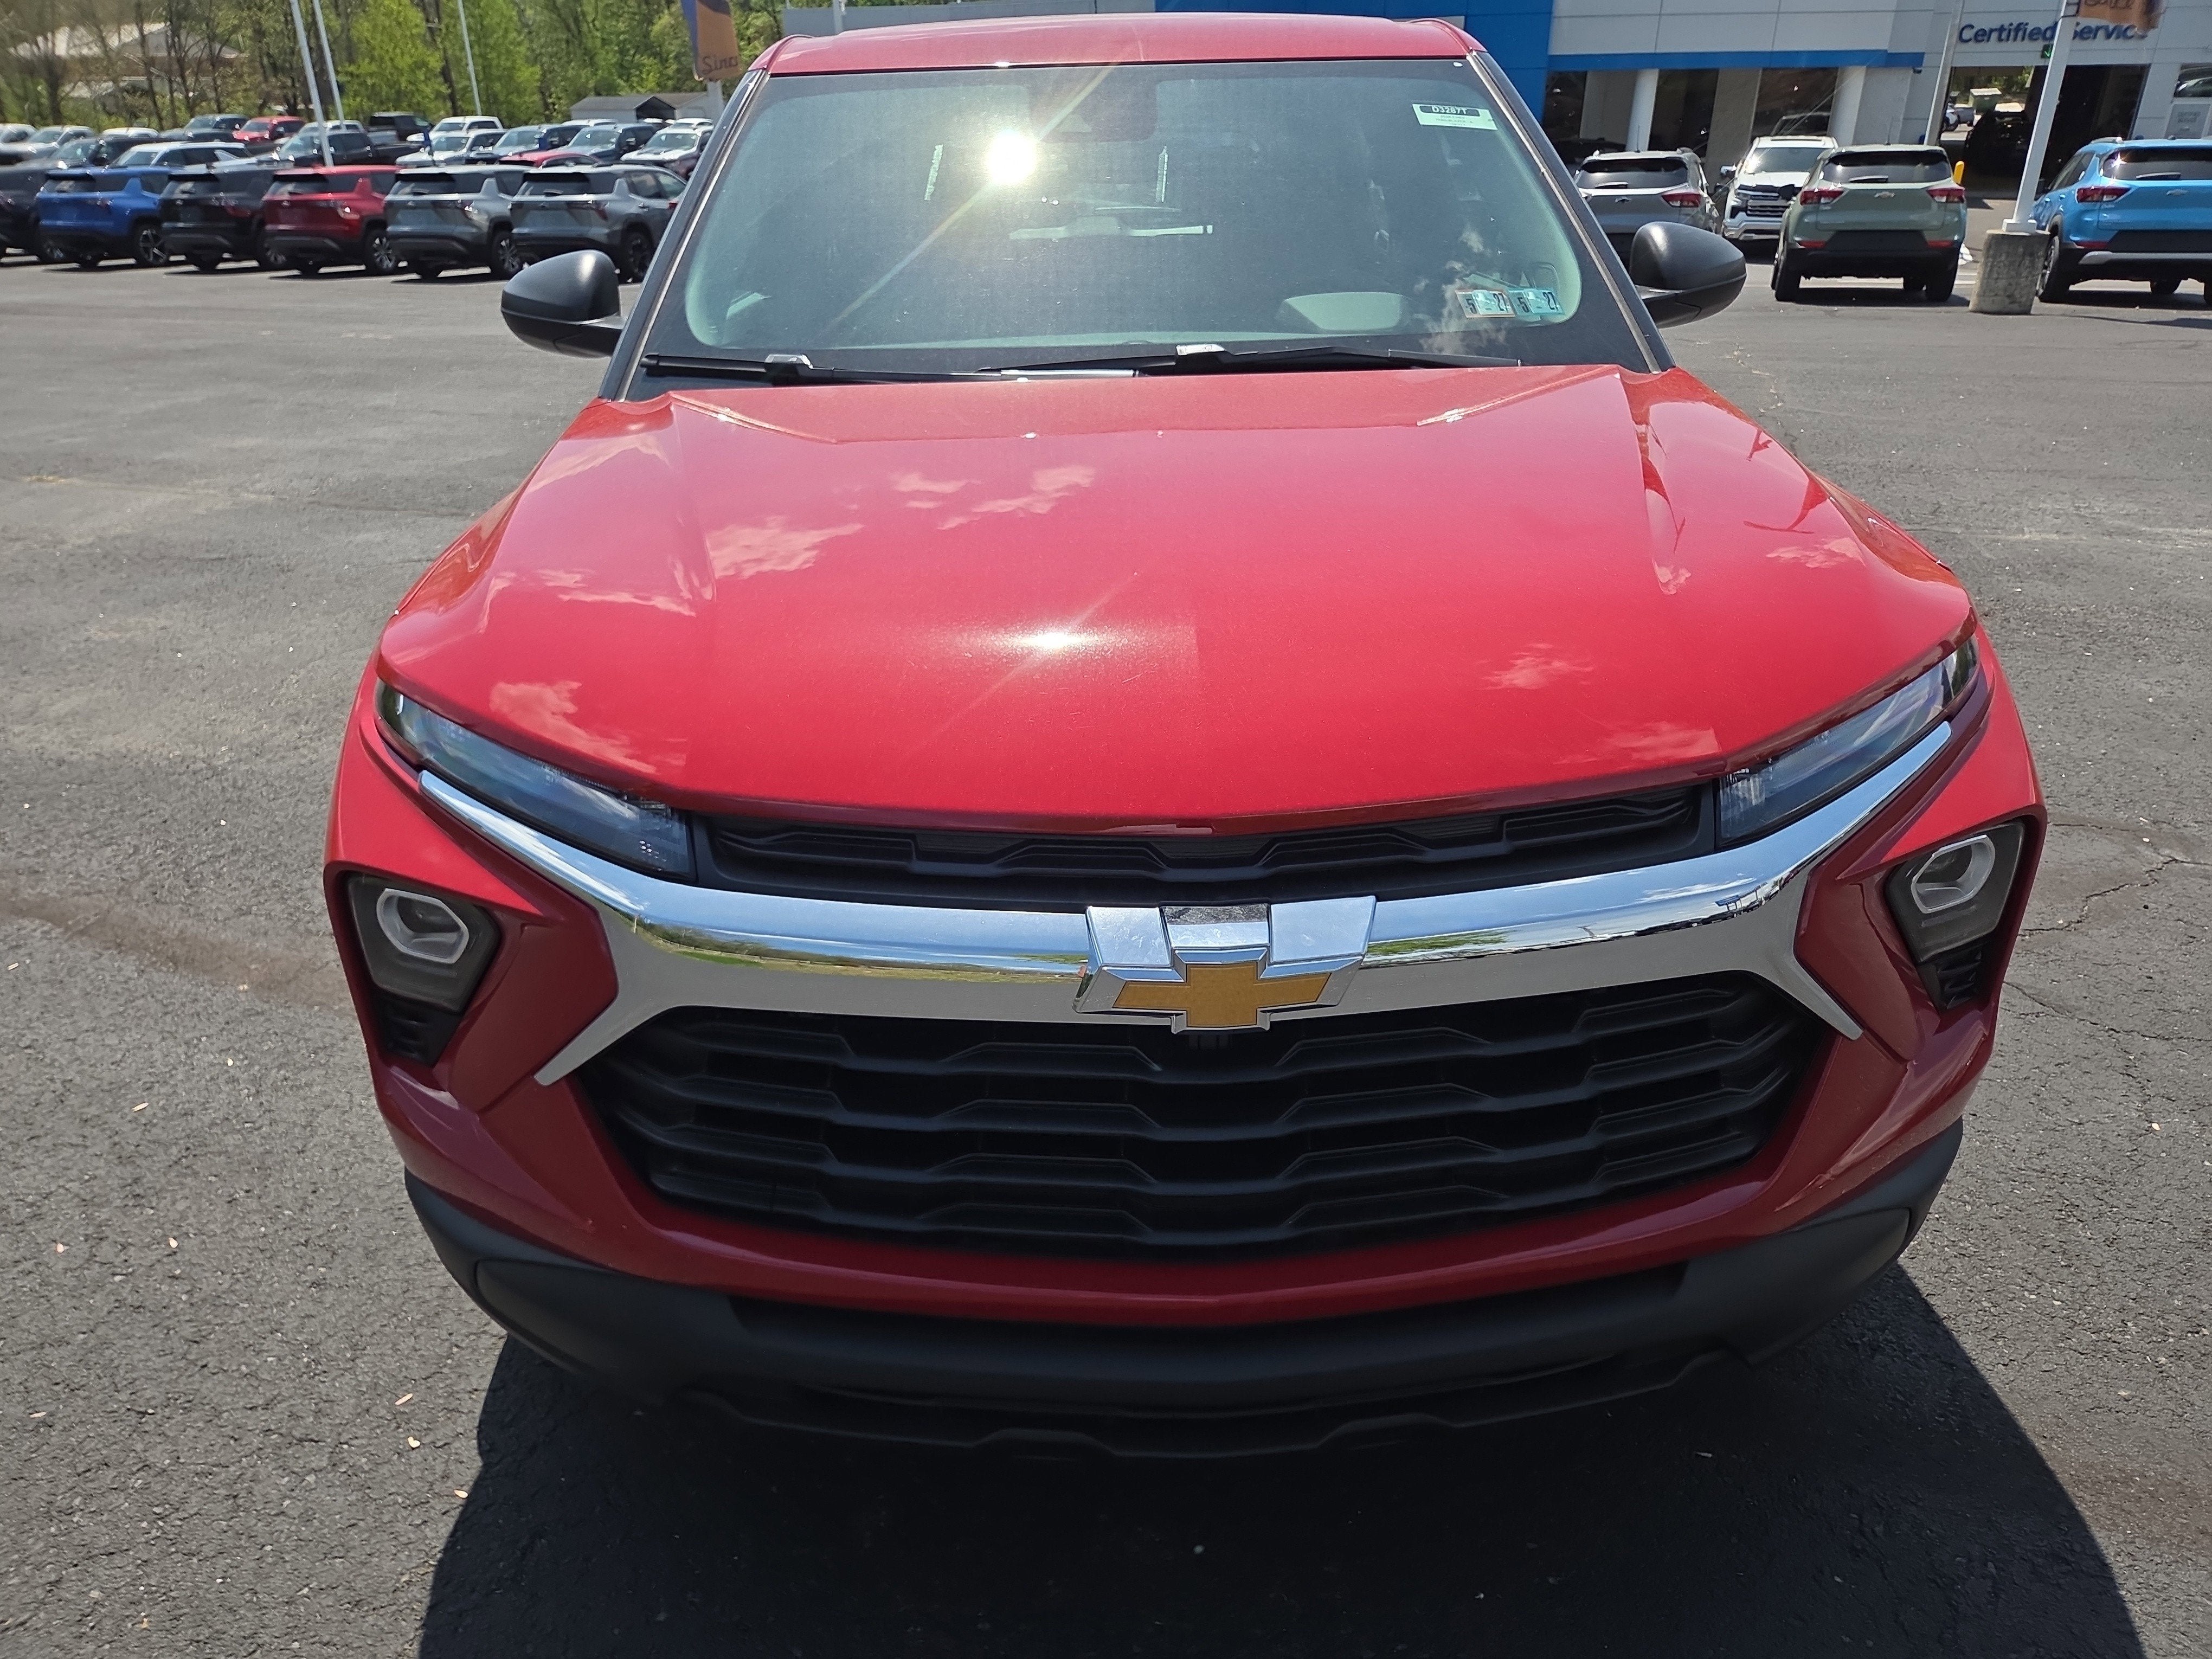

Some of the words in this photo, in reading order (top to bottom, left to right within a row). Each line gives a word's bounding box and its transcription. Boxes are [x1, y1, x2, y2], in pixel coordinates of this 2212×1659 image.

[1958, 21, 2059, 43] Certified
[1432, 105, 1468, 115] D3287T
[1465, 299, 1477, 314] 5
[1493, 293, 1508, 312] 27
[1518, 297, 1529, 313] 5
[1542, 292, 1559, 311] 27
